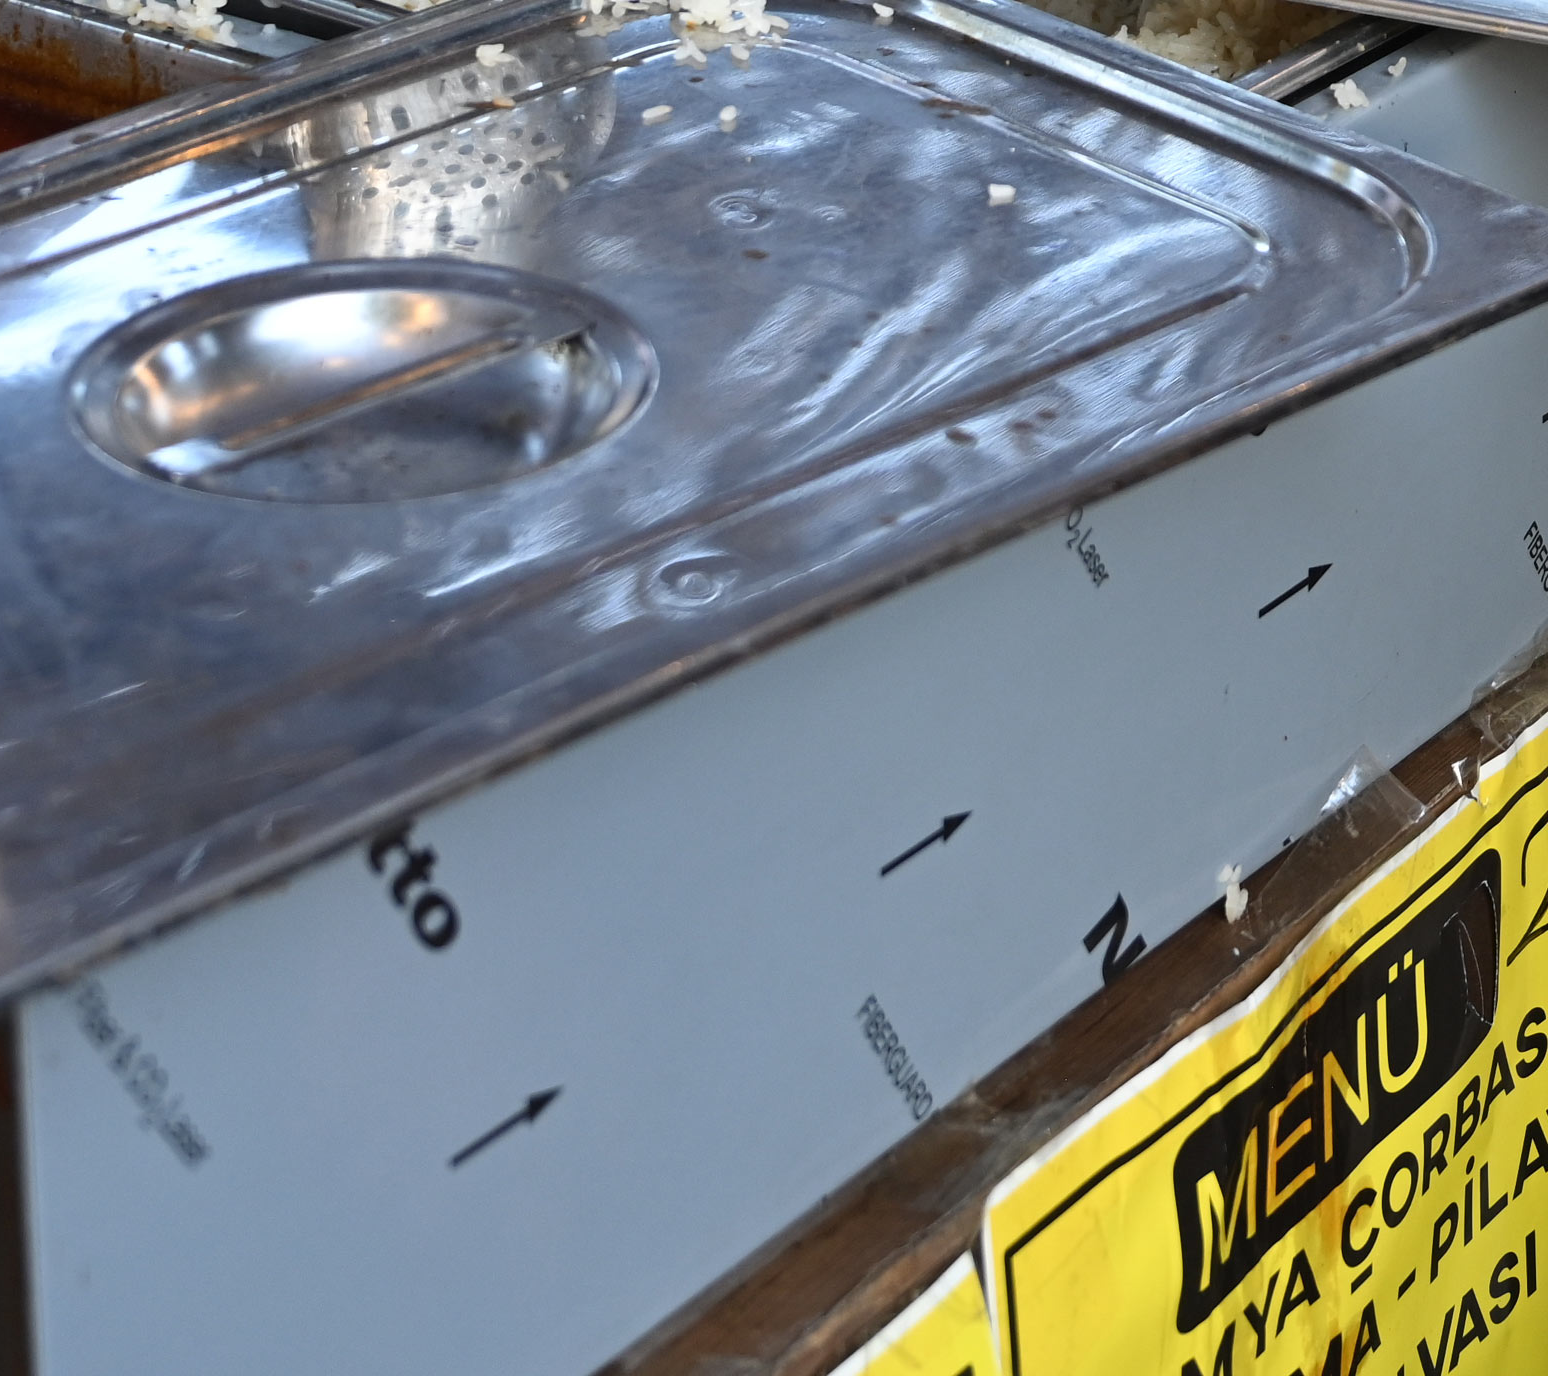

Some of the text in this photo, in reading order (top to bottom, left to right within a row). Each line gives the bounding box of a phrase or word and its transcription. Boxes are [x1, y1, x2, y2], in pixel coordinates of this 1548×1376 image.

[855, 993, 934, 1123] FIBERGUARD
[1194, 949, 1430, 1294] MENÜ
[1396, 1229, 1538, 1376] VASI
